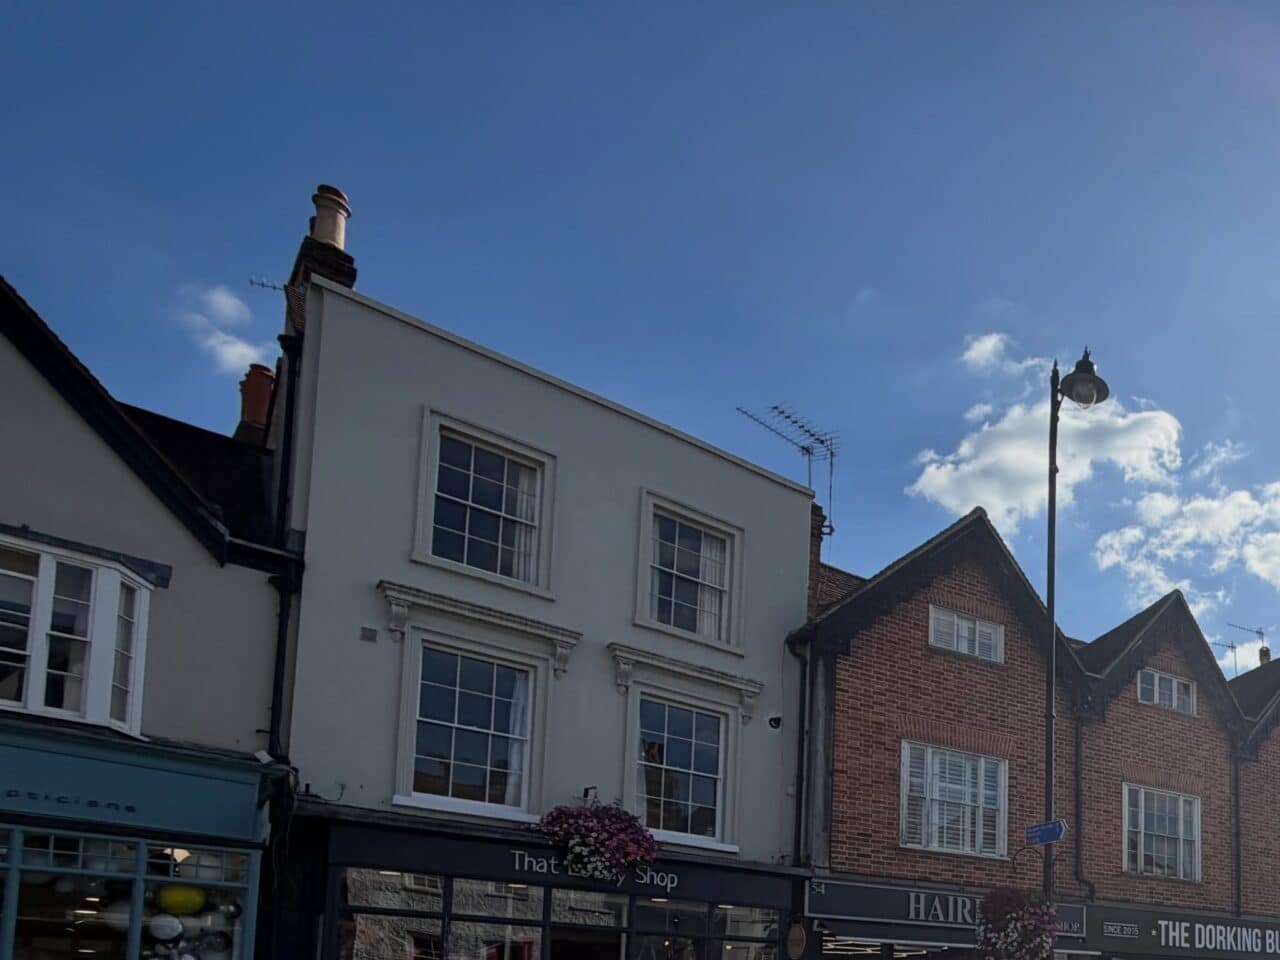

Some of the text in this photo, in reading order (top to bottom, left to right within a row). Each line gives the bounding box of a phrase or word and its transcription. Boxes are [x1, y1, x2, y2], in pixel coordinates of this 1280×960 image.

[510, 849, 561, 875] That
[635, 864, 678, 893] Shop
[1157, 920, 1191, 948] THE
[1194, 923, 1262, 953] DORKING
